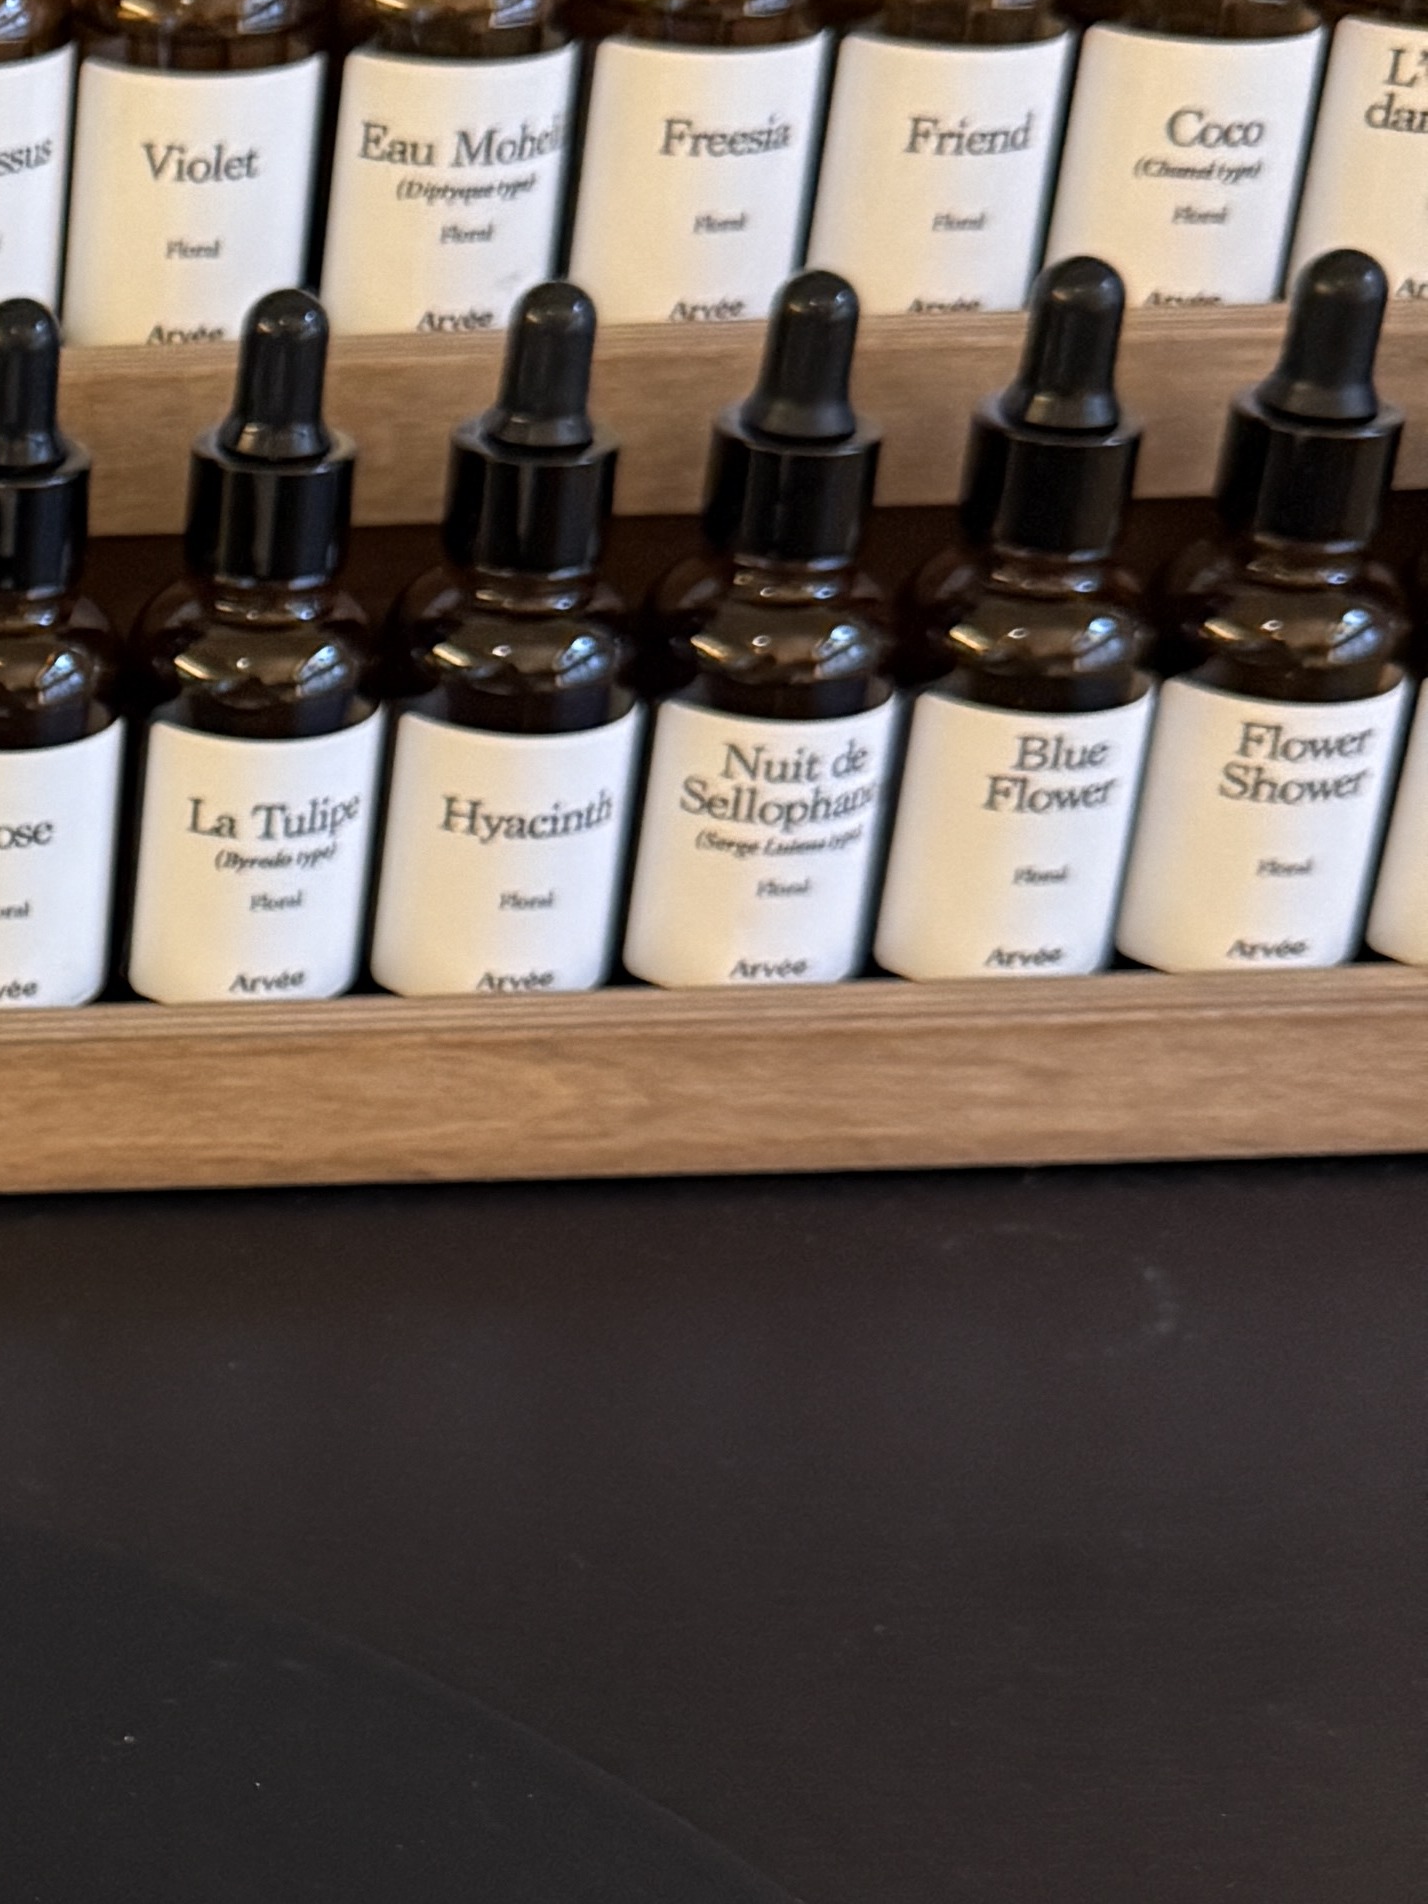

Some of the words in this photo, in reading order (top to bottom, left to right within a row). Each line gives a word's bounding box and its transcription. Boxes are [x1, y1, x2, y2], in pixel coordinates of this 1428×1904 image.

[358, 120, 436, 166] Eau
[659, 111, 792, 157] Freesia
[903, 112, 1034, 156] Friend
[1166, 107, 1264, 147] Coco
[141, 139, 260, 184] Violet
[417, 307, 493, 333] Arvée
[669, 298, 745, 322] Arvée
[148, 323, 225, 345] Arvée
[720, 743, 822, 783] Nuit
[832, 738, 869, 778] de
[1013, 734, 1108, 773] Blue
[1237, 720, 1375, 764] Flower
[983, 774, 1117, 815] Flower
[1218, 761, 1372, 806] Shower
[188, 797, 237, 839] La
[251, 794, 360, 840] Tulipe
[442, 793, 613, 843] Hyacinth
[729, 956, 808, 980] Arvée
[984, 944, 1063, 969] Arvée
[1227, 935, 1307, 961] Arvée
[229, 969, 305, 993] Arvée
[477, 969, 554, 992] Arvée
